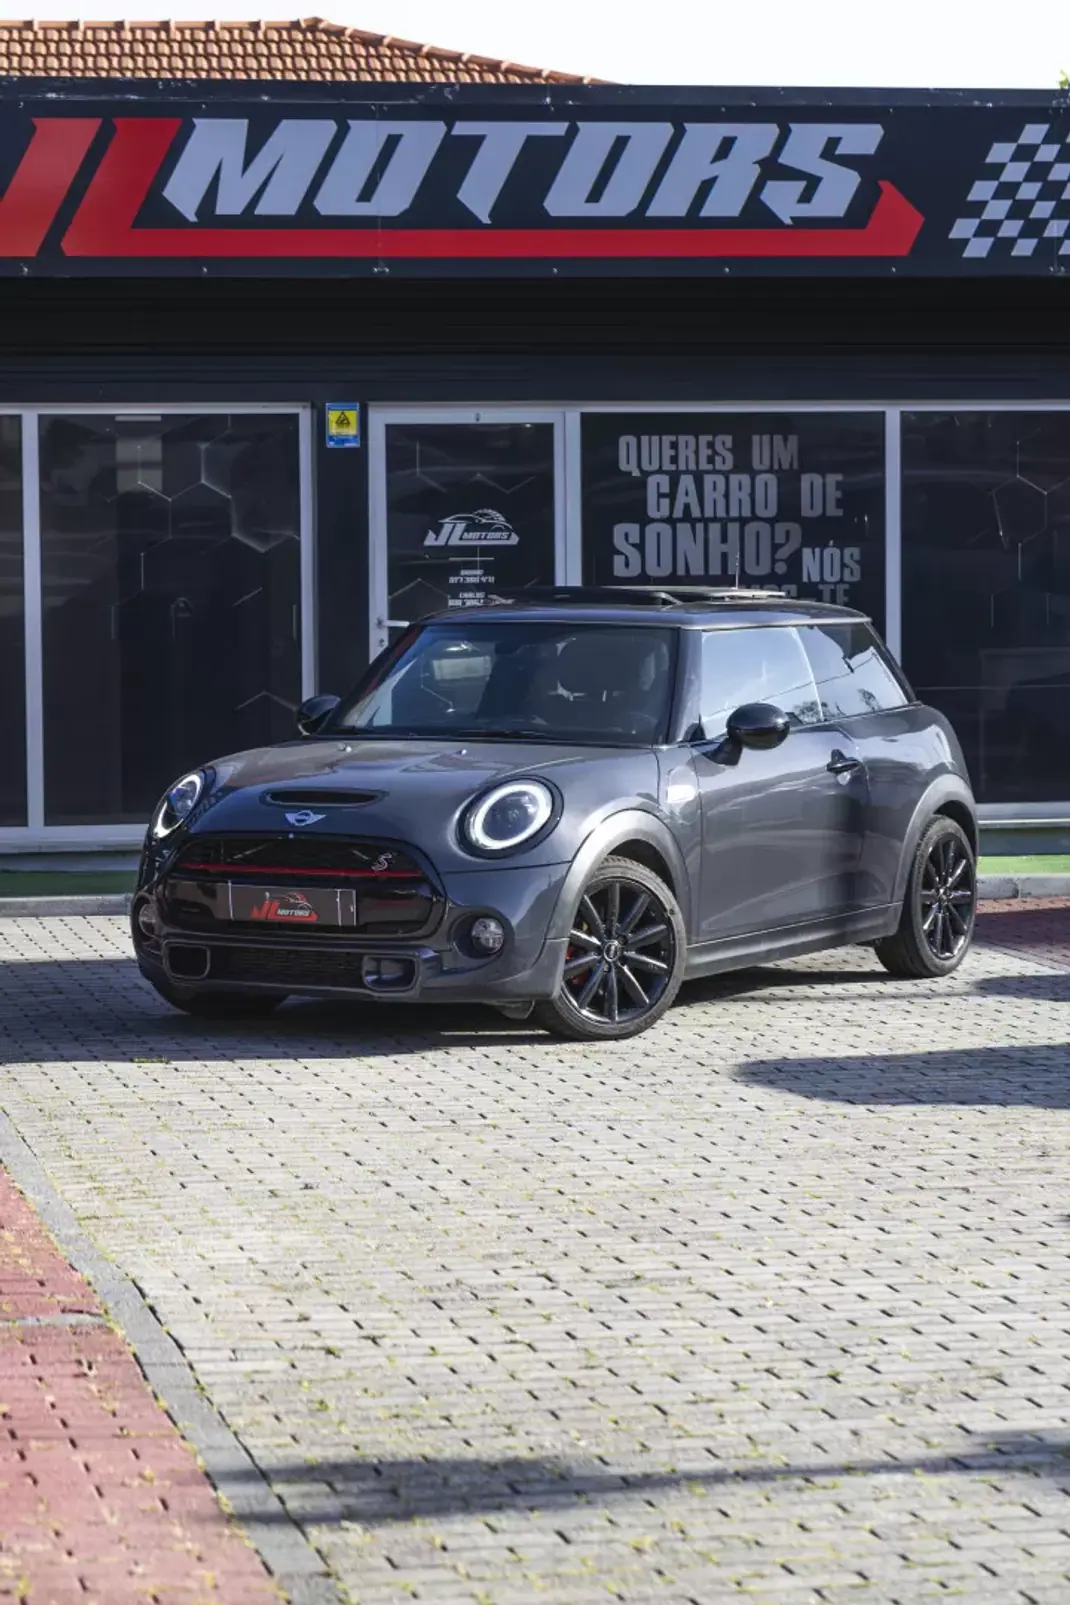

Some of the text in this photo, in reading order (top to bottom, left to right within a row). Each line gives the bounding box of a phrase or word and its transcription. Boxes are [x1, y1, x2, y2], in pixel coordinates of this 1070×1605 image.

[162, 118, 884, 223] MOTORS
[618, 434, 799, 476] QUERES UM
[647, 473, 844, 518] CARRO DE
[462, 532, 510, 540] MOTORS
[613, 522, 861, 582] SONHO? NÓS
